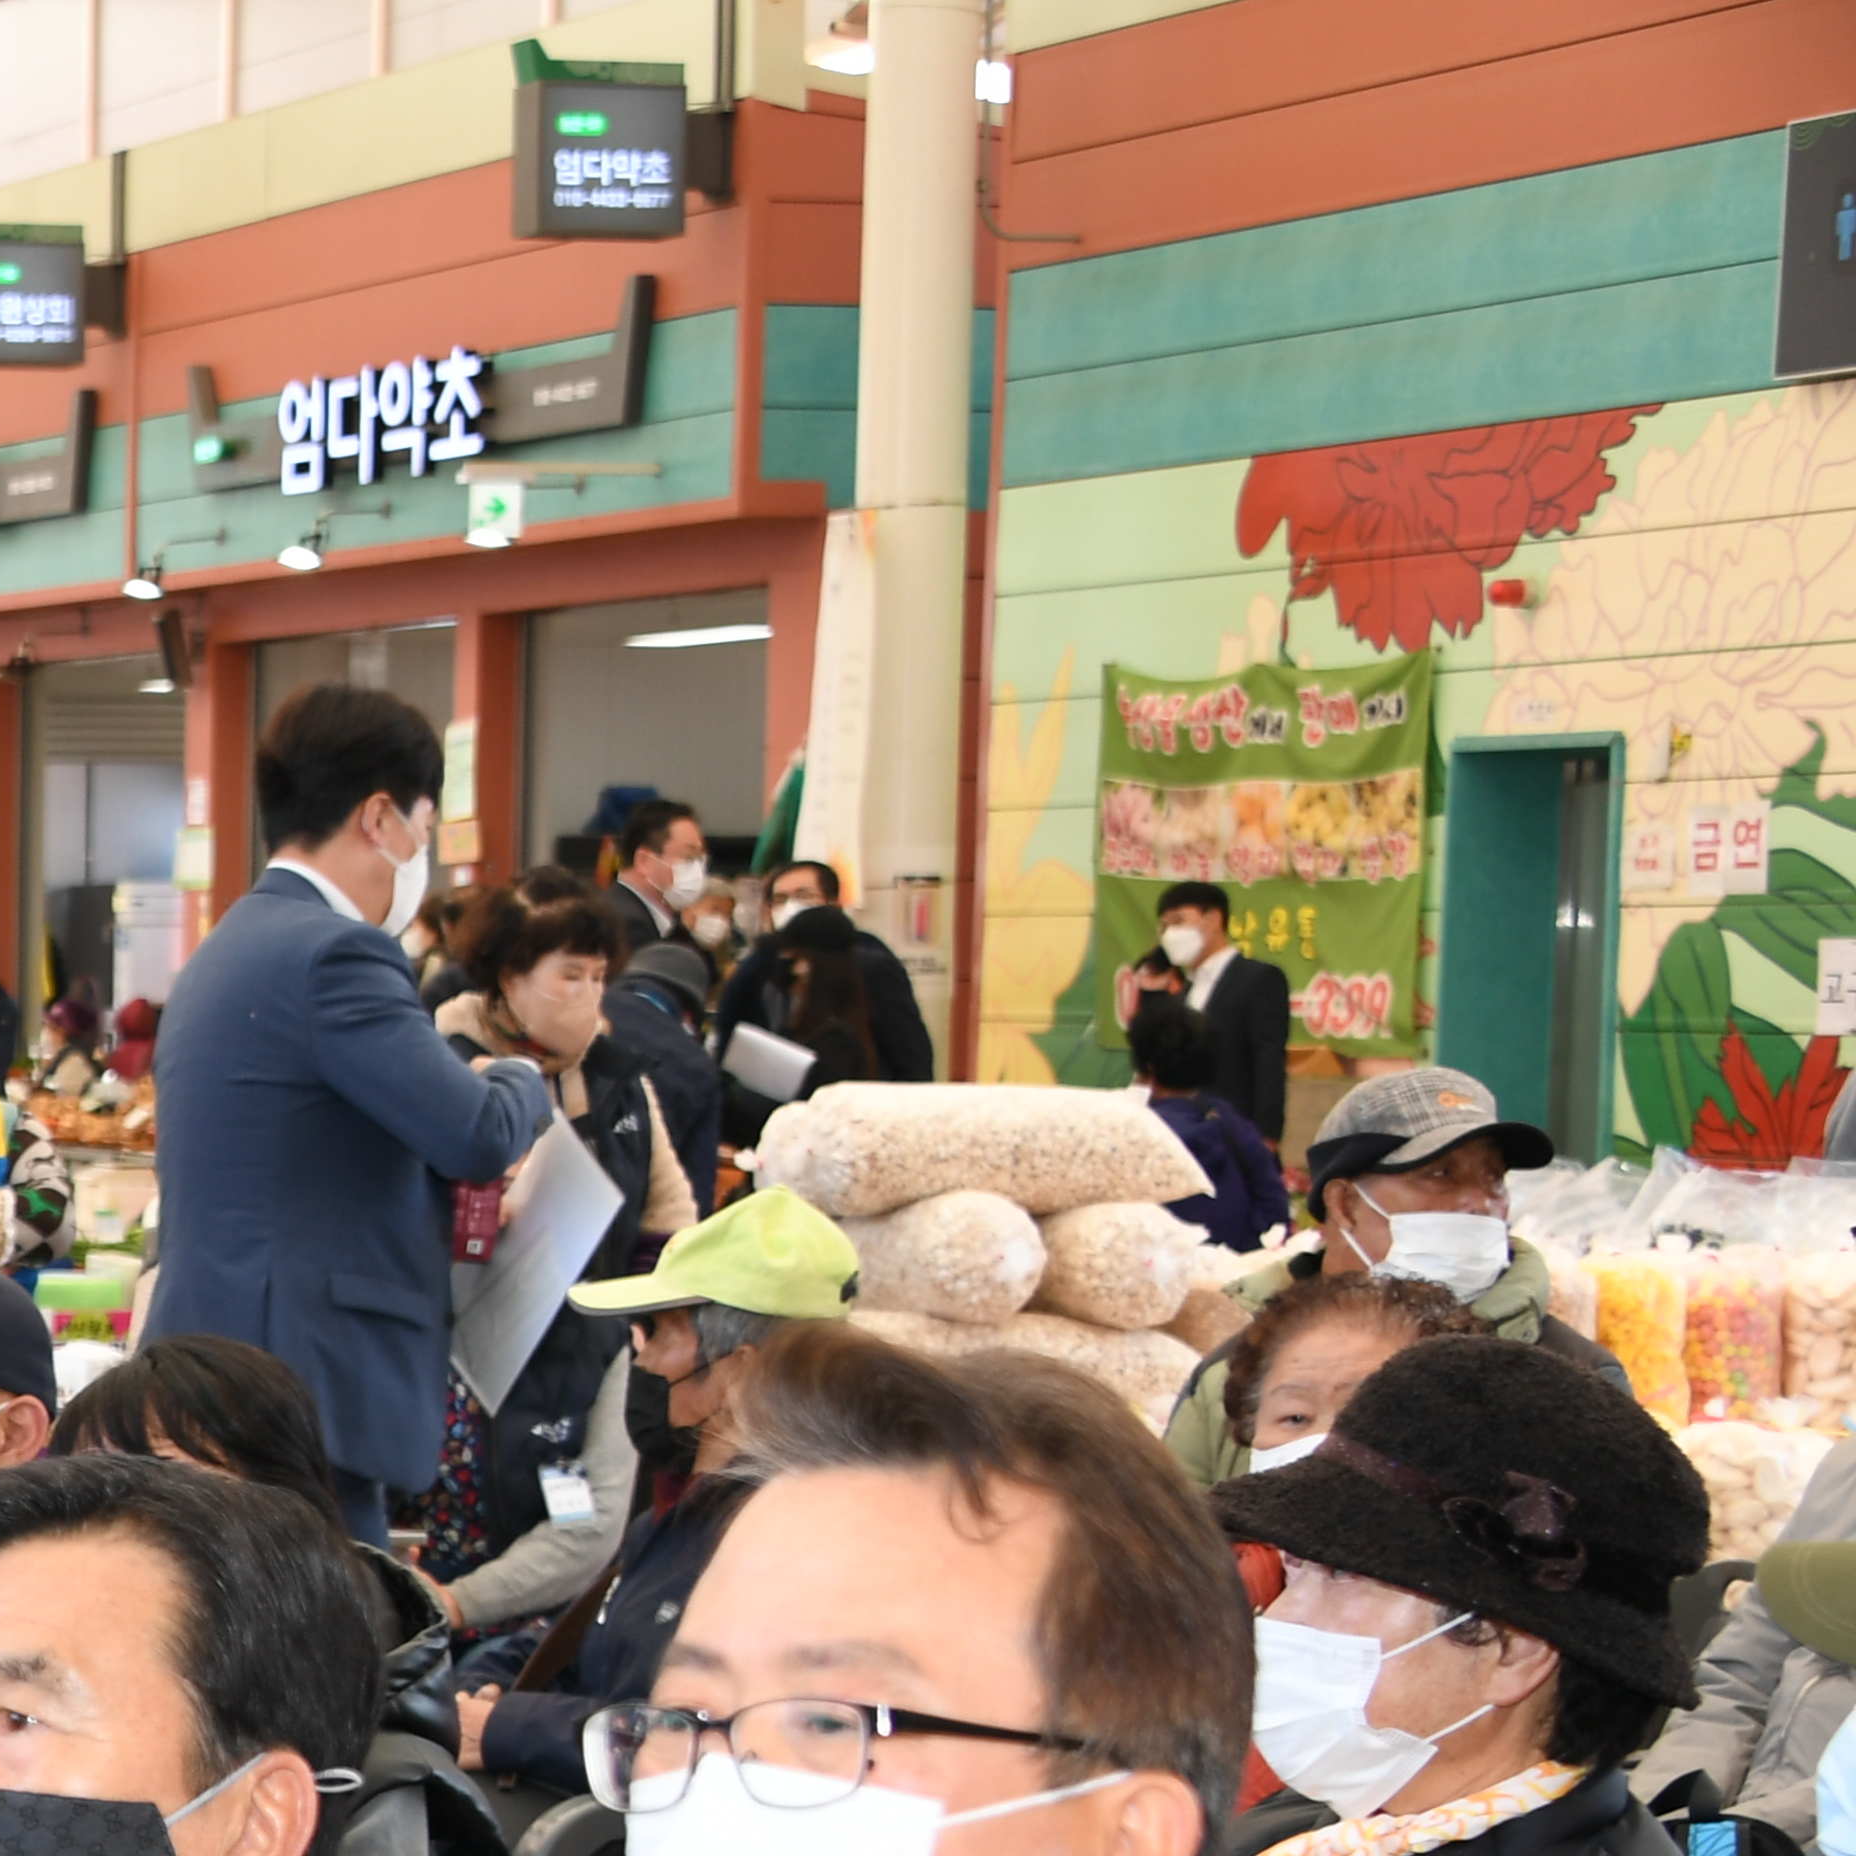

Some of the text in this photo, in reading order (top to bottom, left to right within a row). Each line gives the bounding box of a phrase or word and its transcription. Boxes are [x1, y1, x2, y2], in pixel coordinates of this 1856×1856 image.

[553, 147, 673, 186] 엄다약초
[277, 344, 486, 497] 엄다약초
[1692, 816, 1763, 873] 금연
